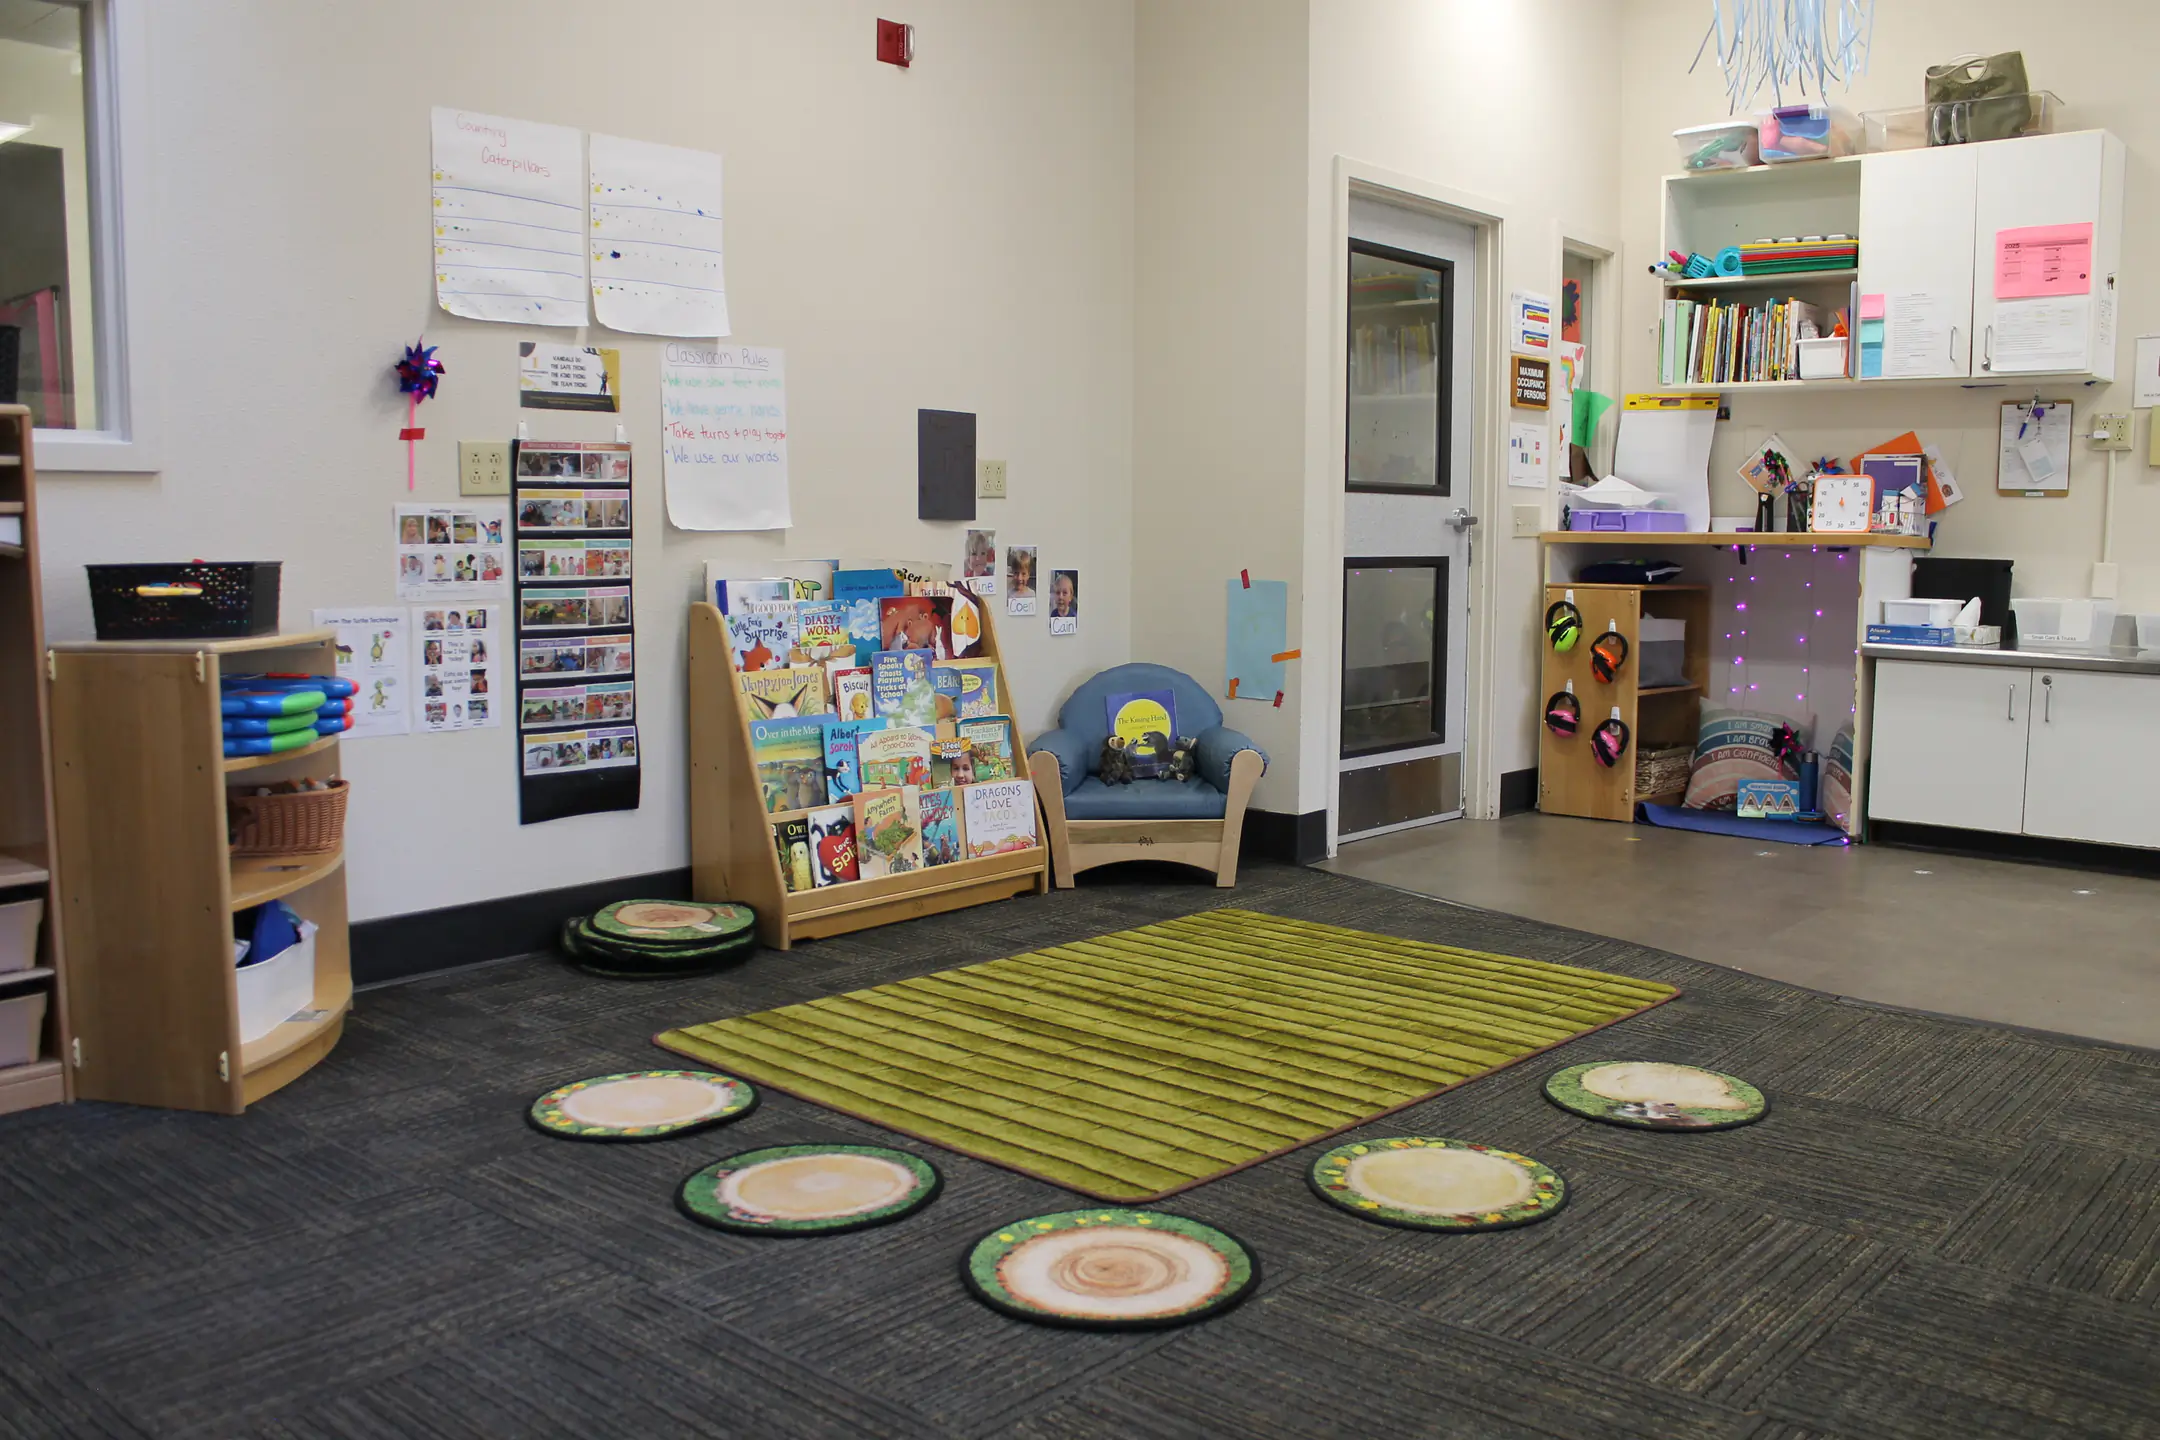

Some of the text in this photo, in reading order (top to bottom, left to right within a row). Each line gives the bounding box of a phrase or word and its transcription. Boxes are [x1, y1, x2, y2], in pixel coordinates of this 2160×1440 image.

[456, 112, 507, 148] Counting
[666, 343, 770, 368] Classroom Rules
[1520, 366, 1544, 378] MAXIMUM
[1516, 377, 1546, 390] OCCUPANCY
[1524, 389, 1546, 400] PERSONS
[668, 420, 695, 440] Take
[700, 424, 730, 440] turns
[742, 428, 762, 442] play
[671, 445, 780, 464] We use our words
[1009, 599, 1034, 612] Coen
[805, 614, 836, 626] DIARY
[1052, 618, 1074, 634] Cain
[744, 628, 788, 644] Surprise
[806, 624, 840, 636] WORM
[878, 662, 904, 670] Spooky
[842, 680, 868, 693] Biscuit
[878, 676, 904, 685] Playing
[880, 690, 904, 698] School
[1150, 713, 1167, 722] Hand
[756, 726, 779, 740] Over
[781, 728, 789, 737] in
[790, 727, 802, 736] the
[878, 734, 899, 746] Aboard
[946, 741, 960, 750] Feel
[942, 749, 961, 759] Proud
[975, 784, 1022, 800] DRAGONS
[866, 795, 896, 815] Anywhere
[985, 798, 1012, 810] LOVE
[879, 805, 896, 818] Farm
[982, 809, 1018, 822] TACOS
